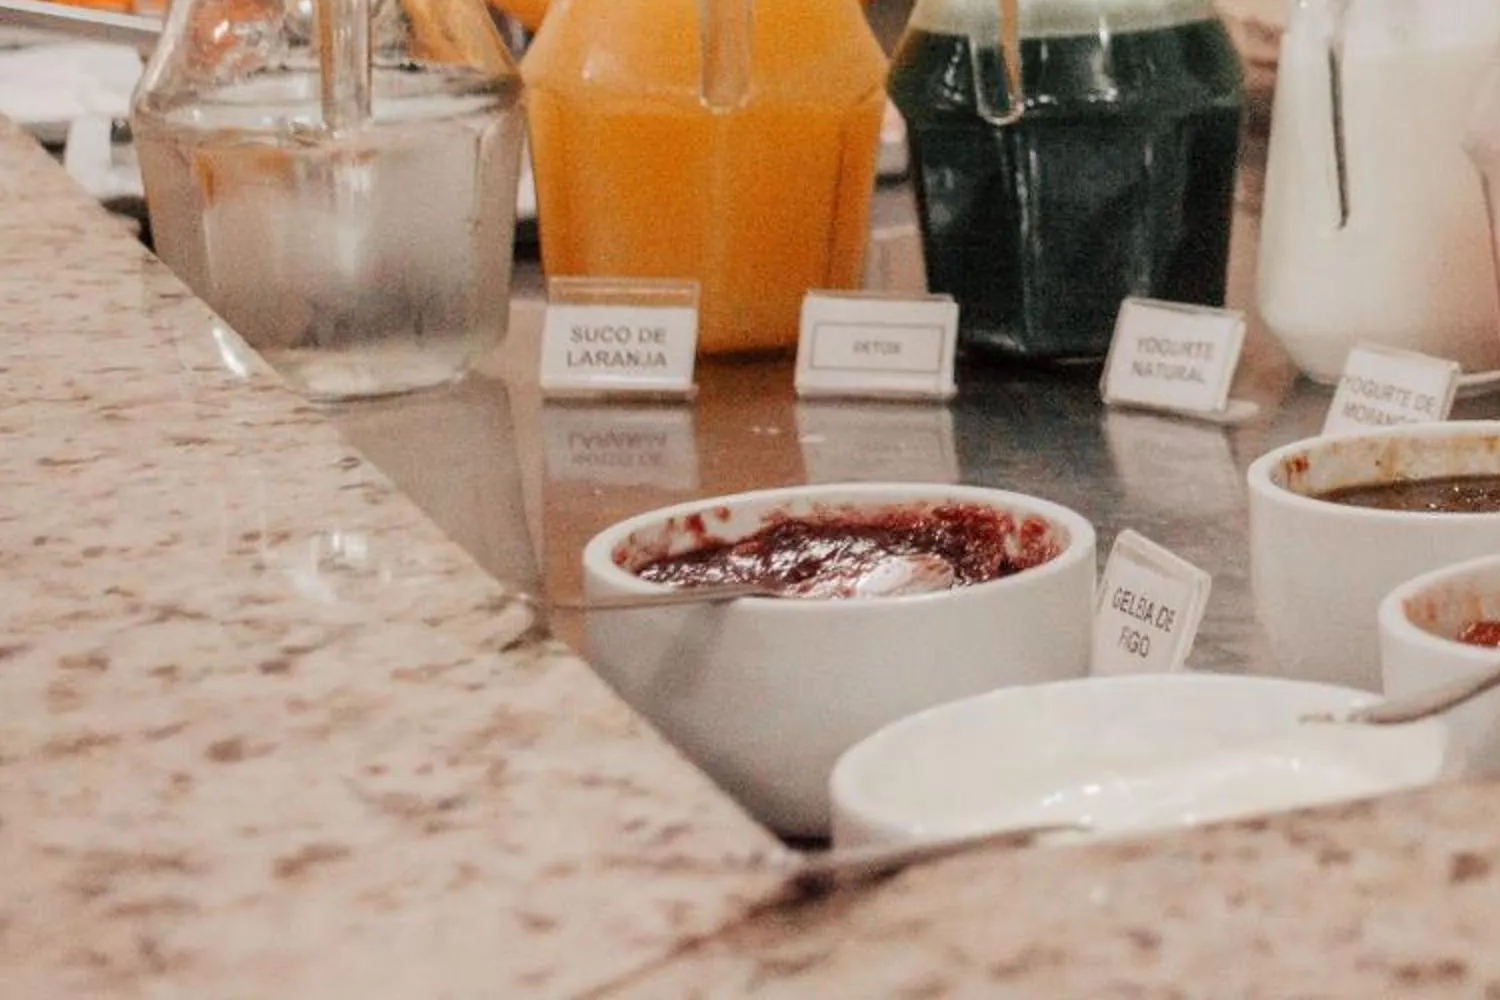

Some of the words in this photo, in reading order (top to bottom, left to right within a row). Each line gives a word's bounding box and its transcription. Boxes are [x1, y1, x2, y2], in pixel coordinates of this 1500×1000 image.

[570, 325, 632, 344] SUCO
[638, 327, 667, 344] DE
[566, 350, 668, 369] LARANJA
[1413, 393, 1436, 414] DE
